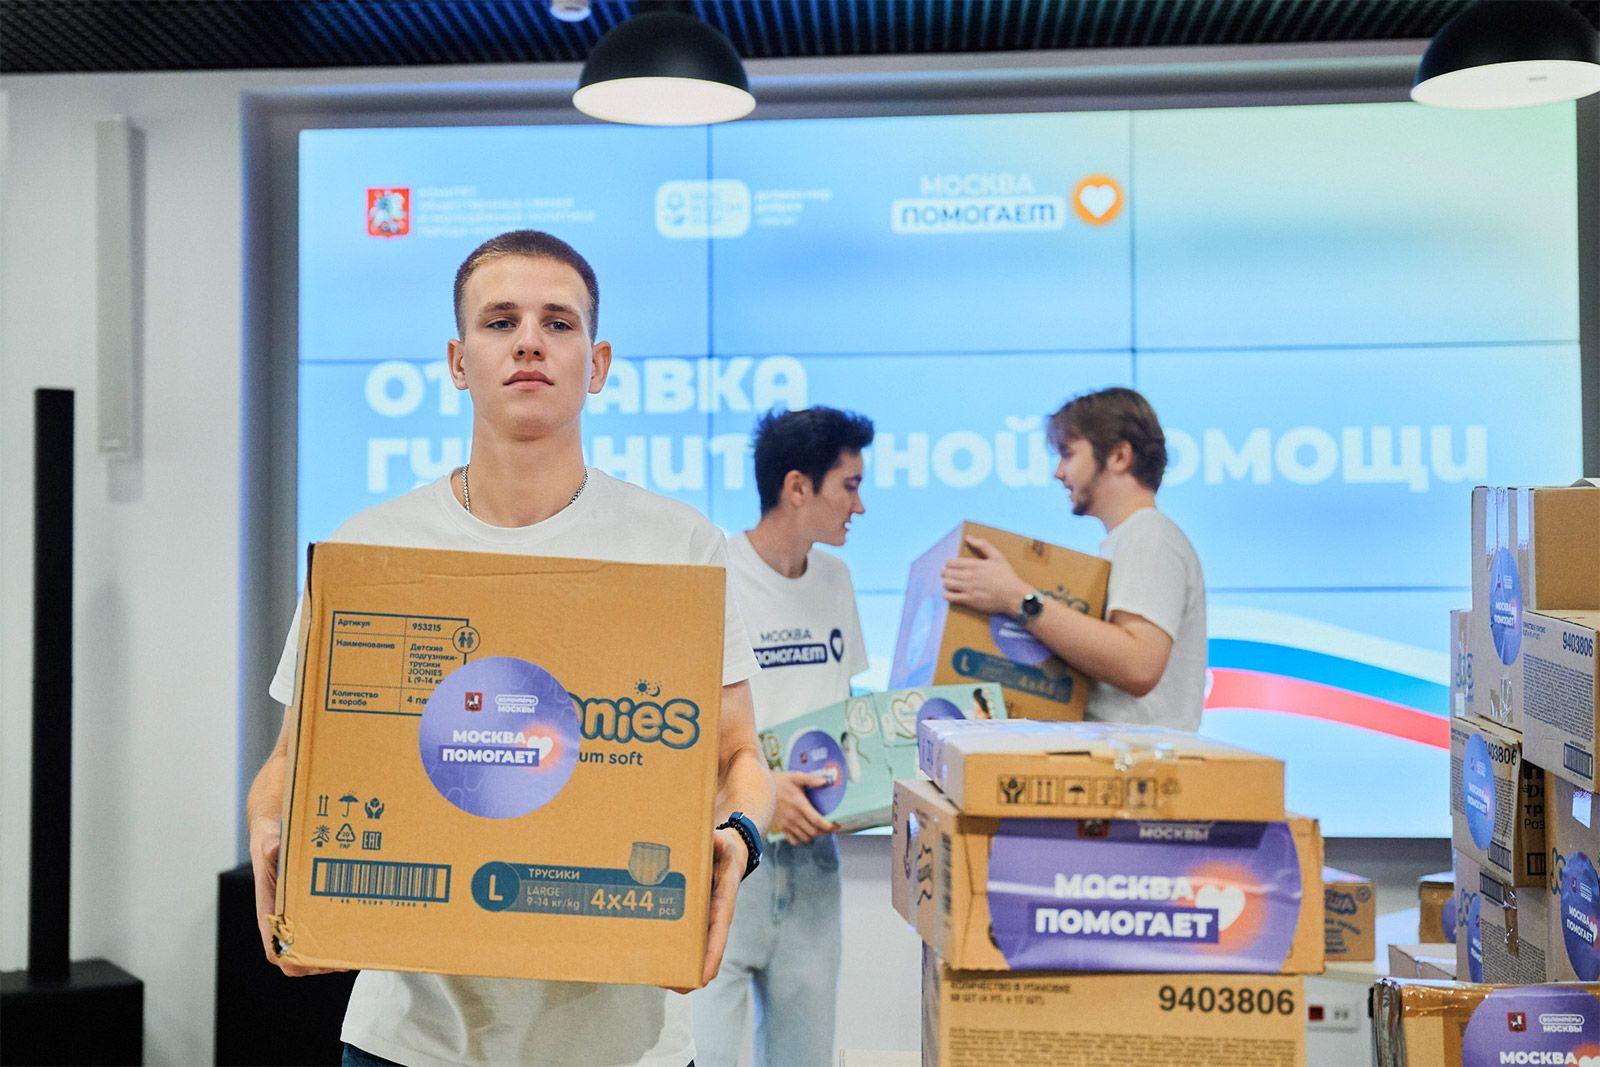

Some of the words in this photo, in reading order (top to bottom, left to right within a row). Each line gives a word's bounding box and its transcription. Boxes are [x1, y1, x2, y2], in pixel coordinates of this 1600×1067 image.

[364, 355, 808, 418] ОТАВКА
[367, 414, 1049, 494] ГУНИТНОЙ
[1163, 425, 1488, 492] ОМОЩИ
[338, 618, 370, 629] Артикул
[412, 622, 441, 632] 953215
[336, 640, 395, 650] Наименование
[410, 643, 443, 652] Детские
[1562, 631, 1594, 658] 9403806
[408, 669, 442, 677] JOONIES
[332, 690, 378, 699] Количество
[453, 730, 527, 744] МОСКВА
[442, 748, 536, 764] ПОМОГАЕТ
[609, 751, 644, 765] soft
[1488, 743, 1518, 766] 03806
[1138, 826, 1210, 840] МОСКВЫ
[528, 868, 580, 880] ТРУСИКИ
[488, 874, 504, 901] L
[527, 886, 561, 897] LARGE
[1054, 873, 1195, 901] МОСКВА
[526, 896, 549, 907] 9-14
[590, 888, 654, 912] 4x44
[658, 907, 677, 916] pcs
[1568, 905, 1590, 927] МОСКВА
[1034, 907, 1213, 939] ПОМОГАЕТ
[1566, 918, 1593, 943] ПОМОГАЕТ
[1158, 985, 1295, 1016] 9403806
[1543, 1025, 1582, 1033] МОСКВЫ
[1499, 1051, 1578, 1065] МОСКВА
